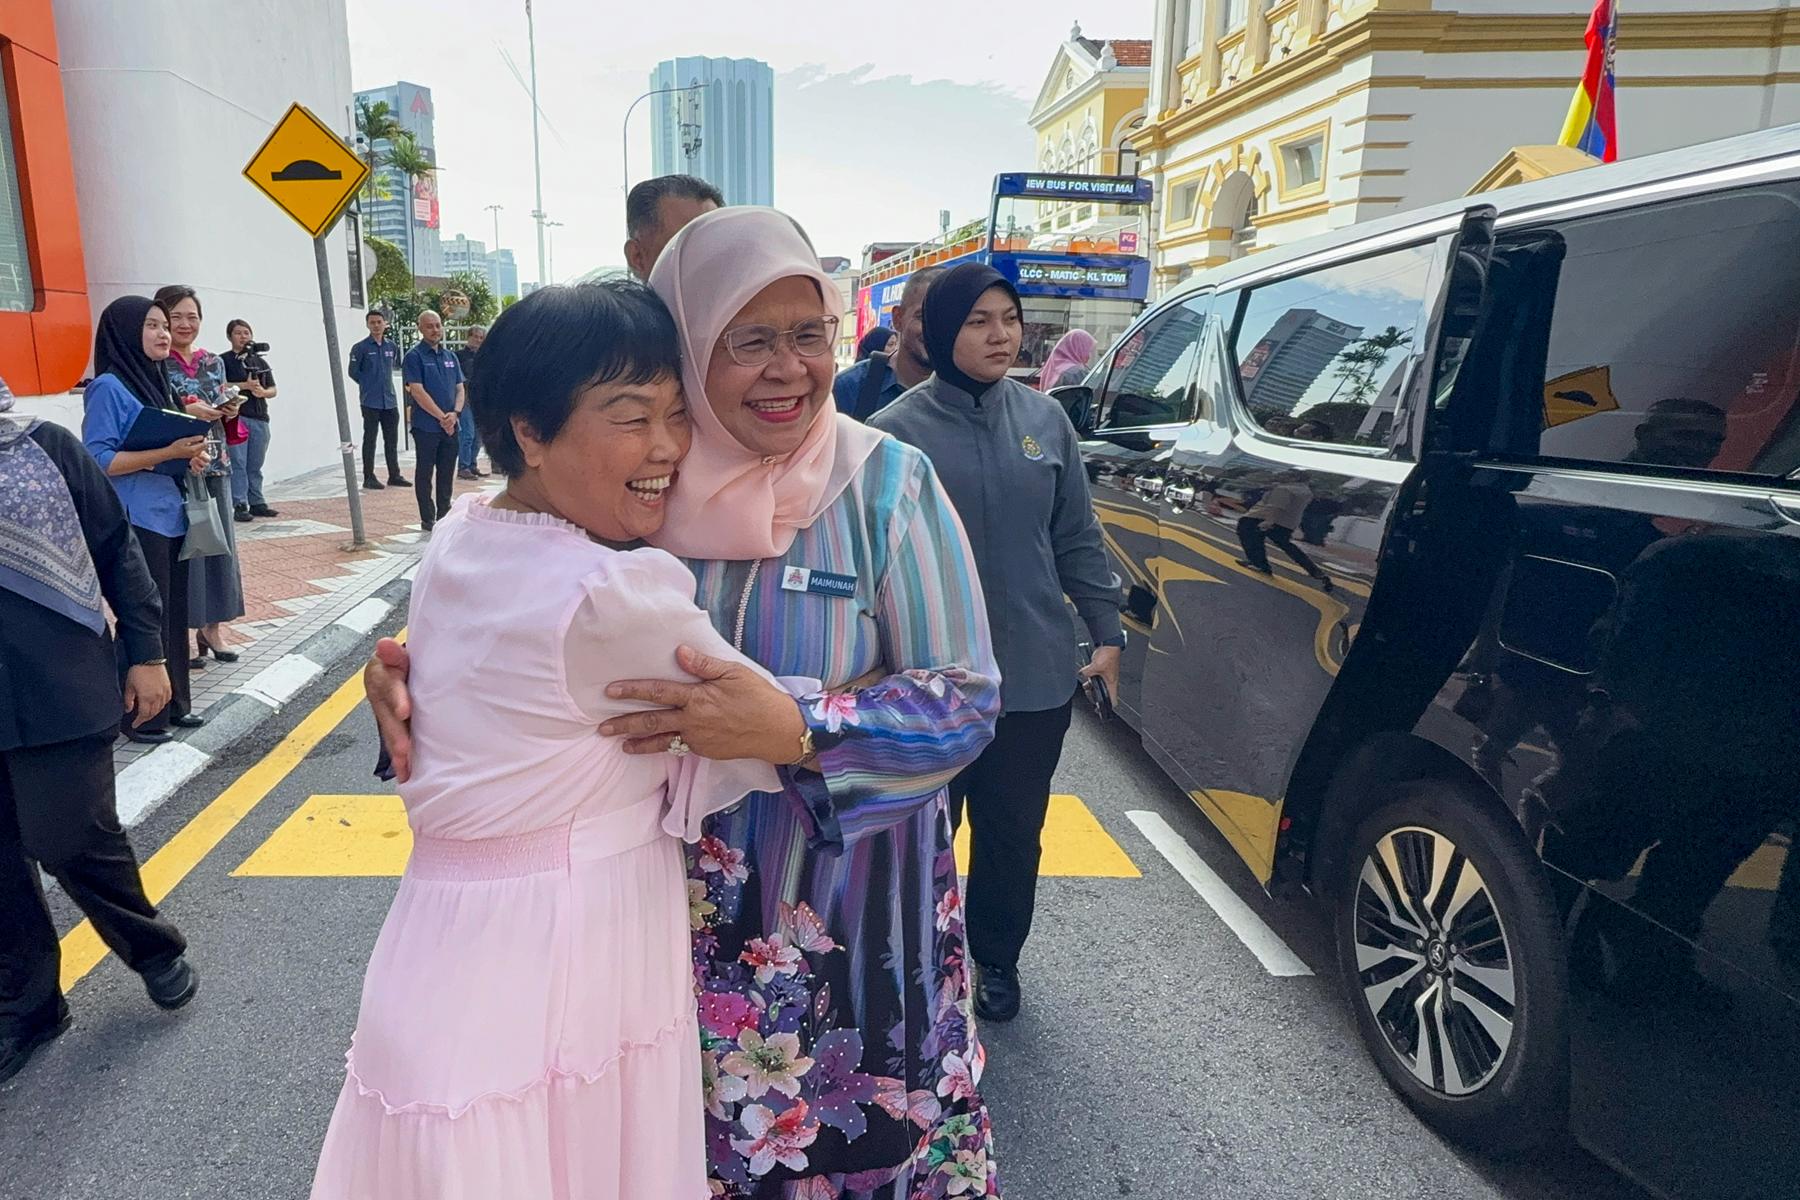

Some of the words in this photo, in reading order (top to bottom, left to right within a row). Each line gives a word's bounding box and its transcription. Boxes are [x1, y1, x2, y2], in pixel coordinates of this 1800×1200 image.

[1046, 180, 1067, 190] BUS
[1068, 181, 1089, 191] FOR
[1090, 183, 1114, 193] VISIT
[1050, 270, 1079, 281] MATIC
[1087, 272, 1100, 281] KL
[811, 577, 854, 591] MAIMUNAH
